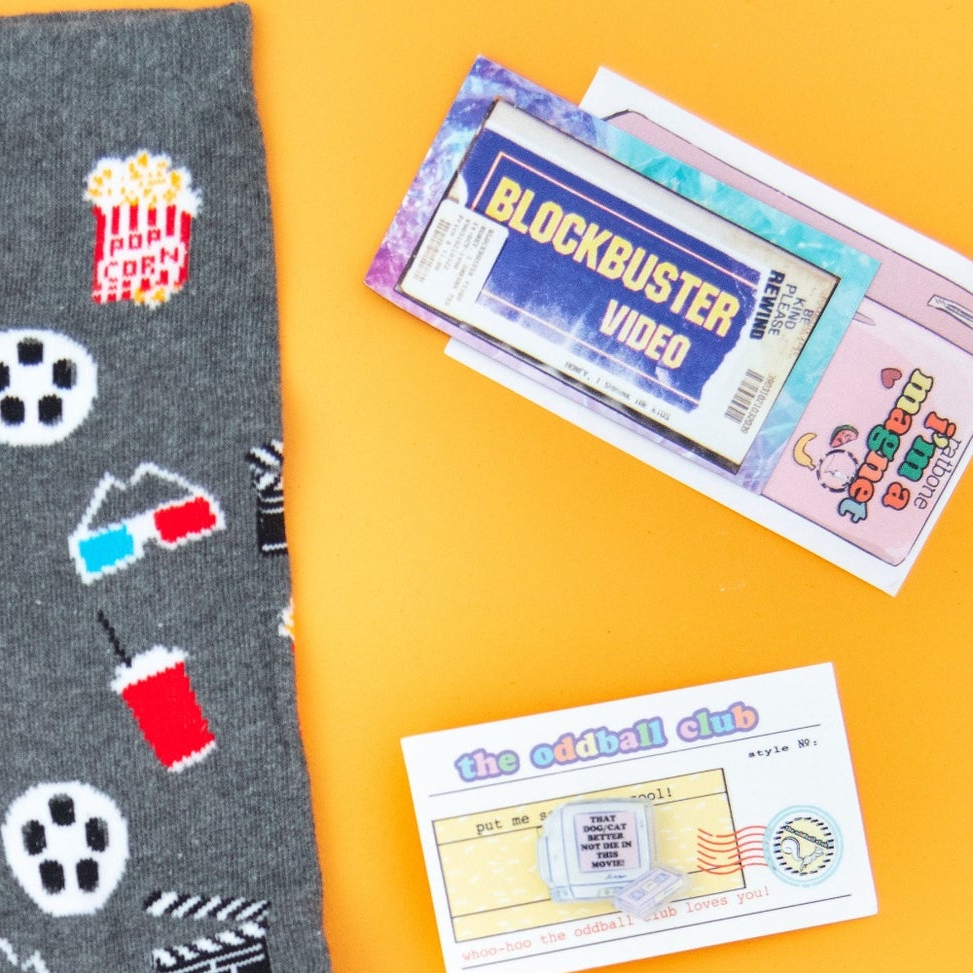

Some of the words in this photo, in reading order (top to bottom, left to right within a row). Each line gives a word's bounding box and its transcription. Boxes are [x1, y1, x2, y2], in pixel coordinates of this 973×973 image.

[110, 229, 160, 257] POP
[486, 176, 741, 339] BLOCKBUSTER
[104, 247, 179, 282] CORN
[749, 270, 786, 341] REWIND
[767, 285, 798, 337] PLEASE
[784, 298, 806, 330] KIND
[801, 309, 815, 326] BE
[599, 299, 692, 371] VIDEO
[838, 367, 934, 524] magnet
[914, 438, 962, 510] ratbone
[882, 482, 911, 511] a
[454, 749, 520, 783] the
[529, 717, 668, 770] oddball
[676, 701, 759, 742] club
[748, 743, 790, 759] style
[630, 787, 673, 802] ool!
[475, 818, 504, 836] put
[512, 813, 530, 826] me
[583, 822, 627, 834] DOG/CAT
[589, 814, 617, 825] THAT
[581, 842, 601, 853] NOT
[603, 841, 620, 851] DIE
[621, 839, 633, 850] IN
[587, 831, 625, 842] BETTER
[596, 850, 619, 861] THIS
[462, 939, 533, 962] whoo-hoo
[540, 929, 566, 944] the
[574, 915, 635, 940] oddball
[686, 895, 728, 914] loves
[737, 886, 770, 906] you!
